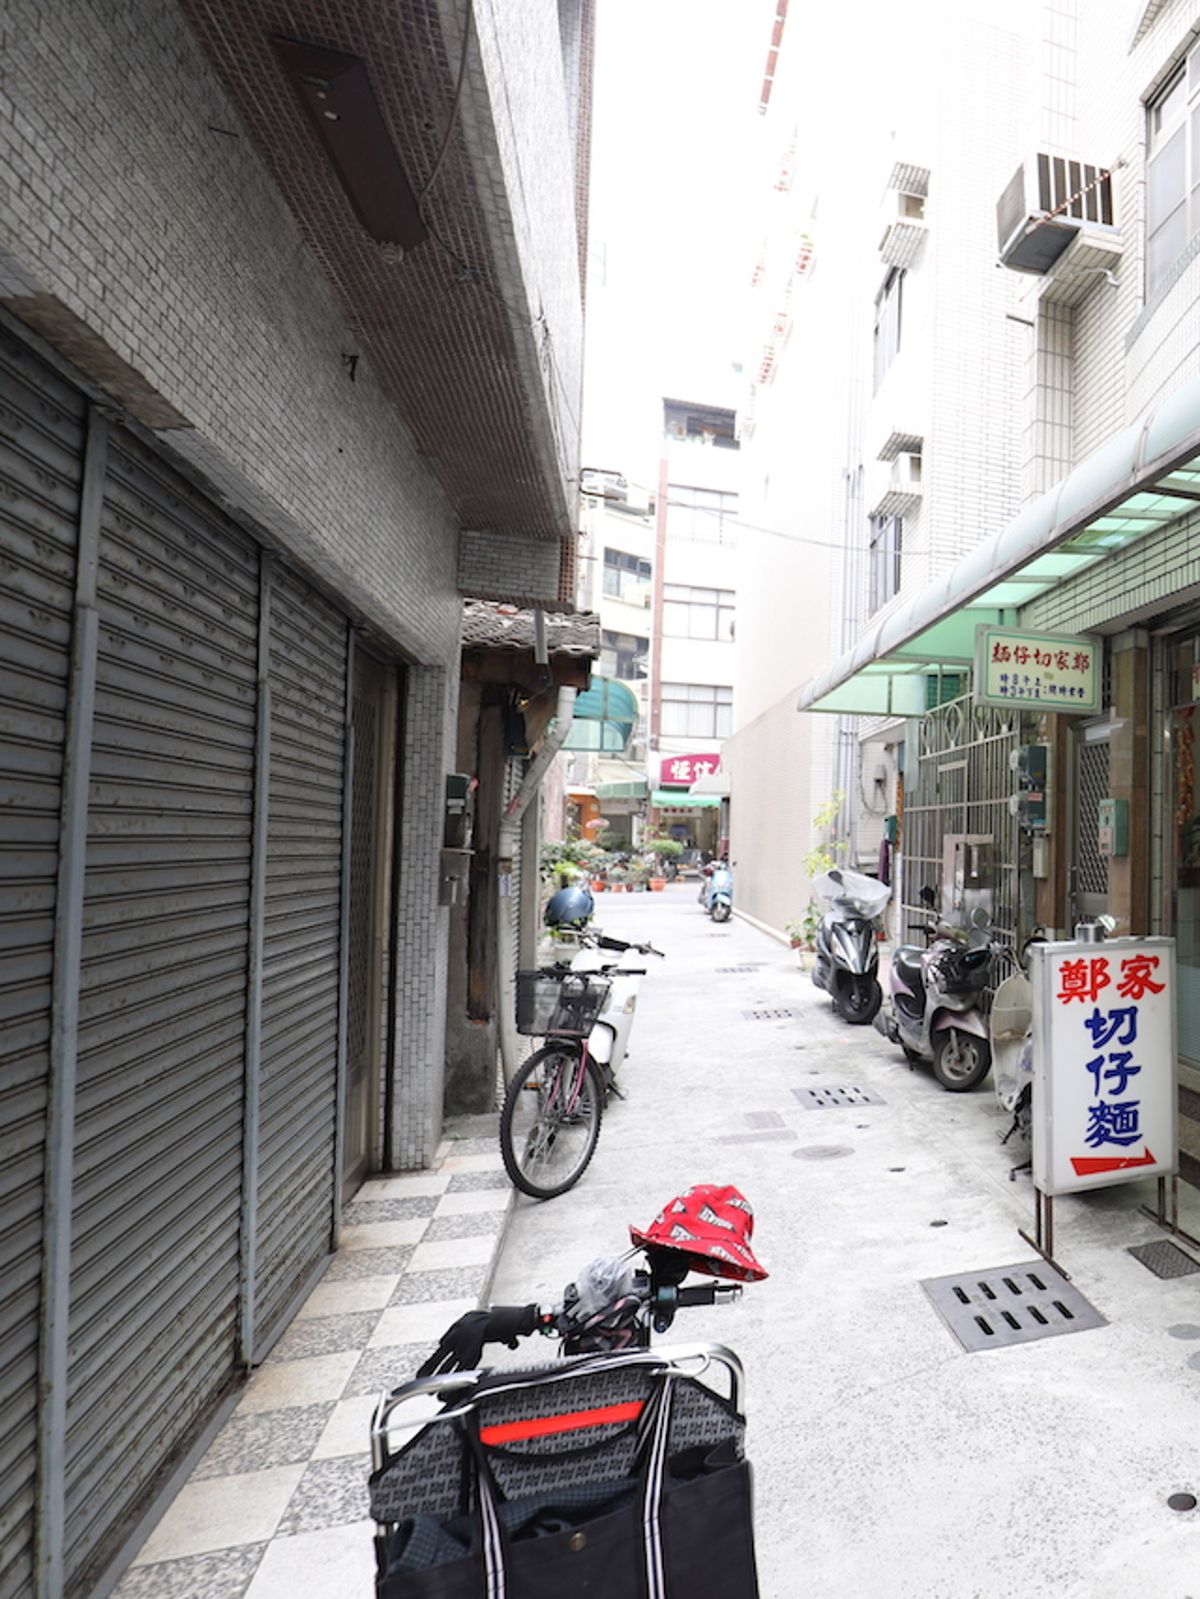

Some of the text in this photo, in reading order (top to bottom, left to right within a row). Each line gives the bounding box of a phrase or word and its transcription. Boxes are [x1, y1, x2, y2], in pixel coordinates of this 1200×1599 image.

[1057, 953, 1166, 1005] 鄭家
[1084, 1006, 1143, 1148] 切仔麵
